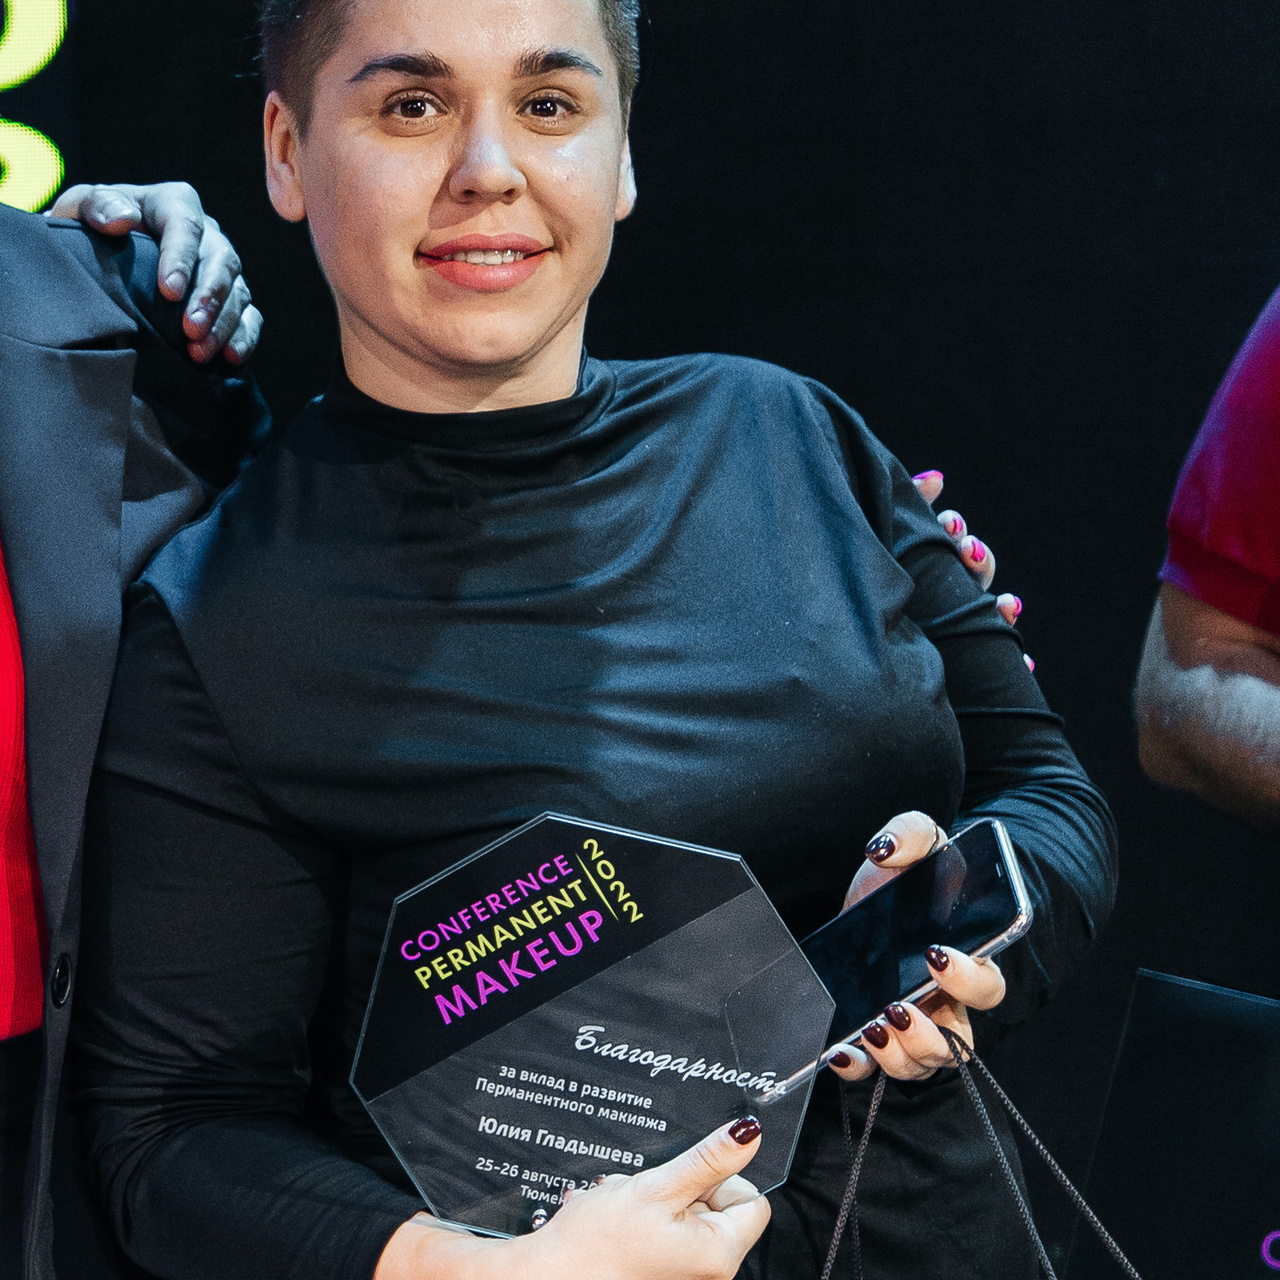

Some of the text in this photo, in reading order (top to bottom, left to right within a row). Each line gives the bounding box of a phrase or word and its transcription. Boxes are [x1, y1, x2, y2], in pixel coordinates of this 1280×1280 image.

[401, 855, 573, 961] CONFERENCE
[583, 838, 644, 923] 2022
[414, 879, 587, 989] PERMANENT
[434, 910, 604, 1025] MAKEUP
[499, 1066, 653, 1109] за вклад в развитие
[574, 1025, 787, 1096] Благодарность
[475, 1077, 668, 1132] Перманентного макияжа
[475, 1157, 520, 1179] 25-26
[521, 1169, 576, 1190] августа
[478, 1116, 645, 1168] Юлия Гладышева
